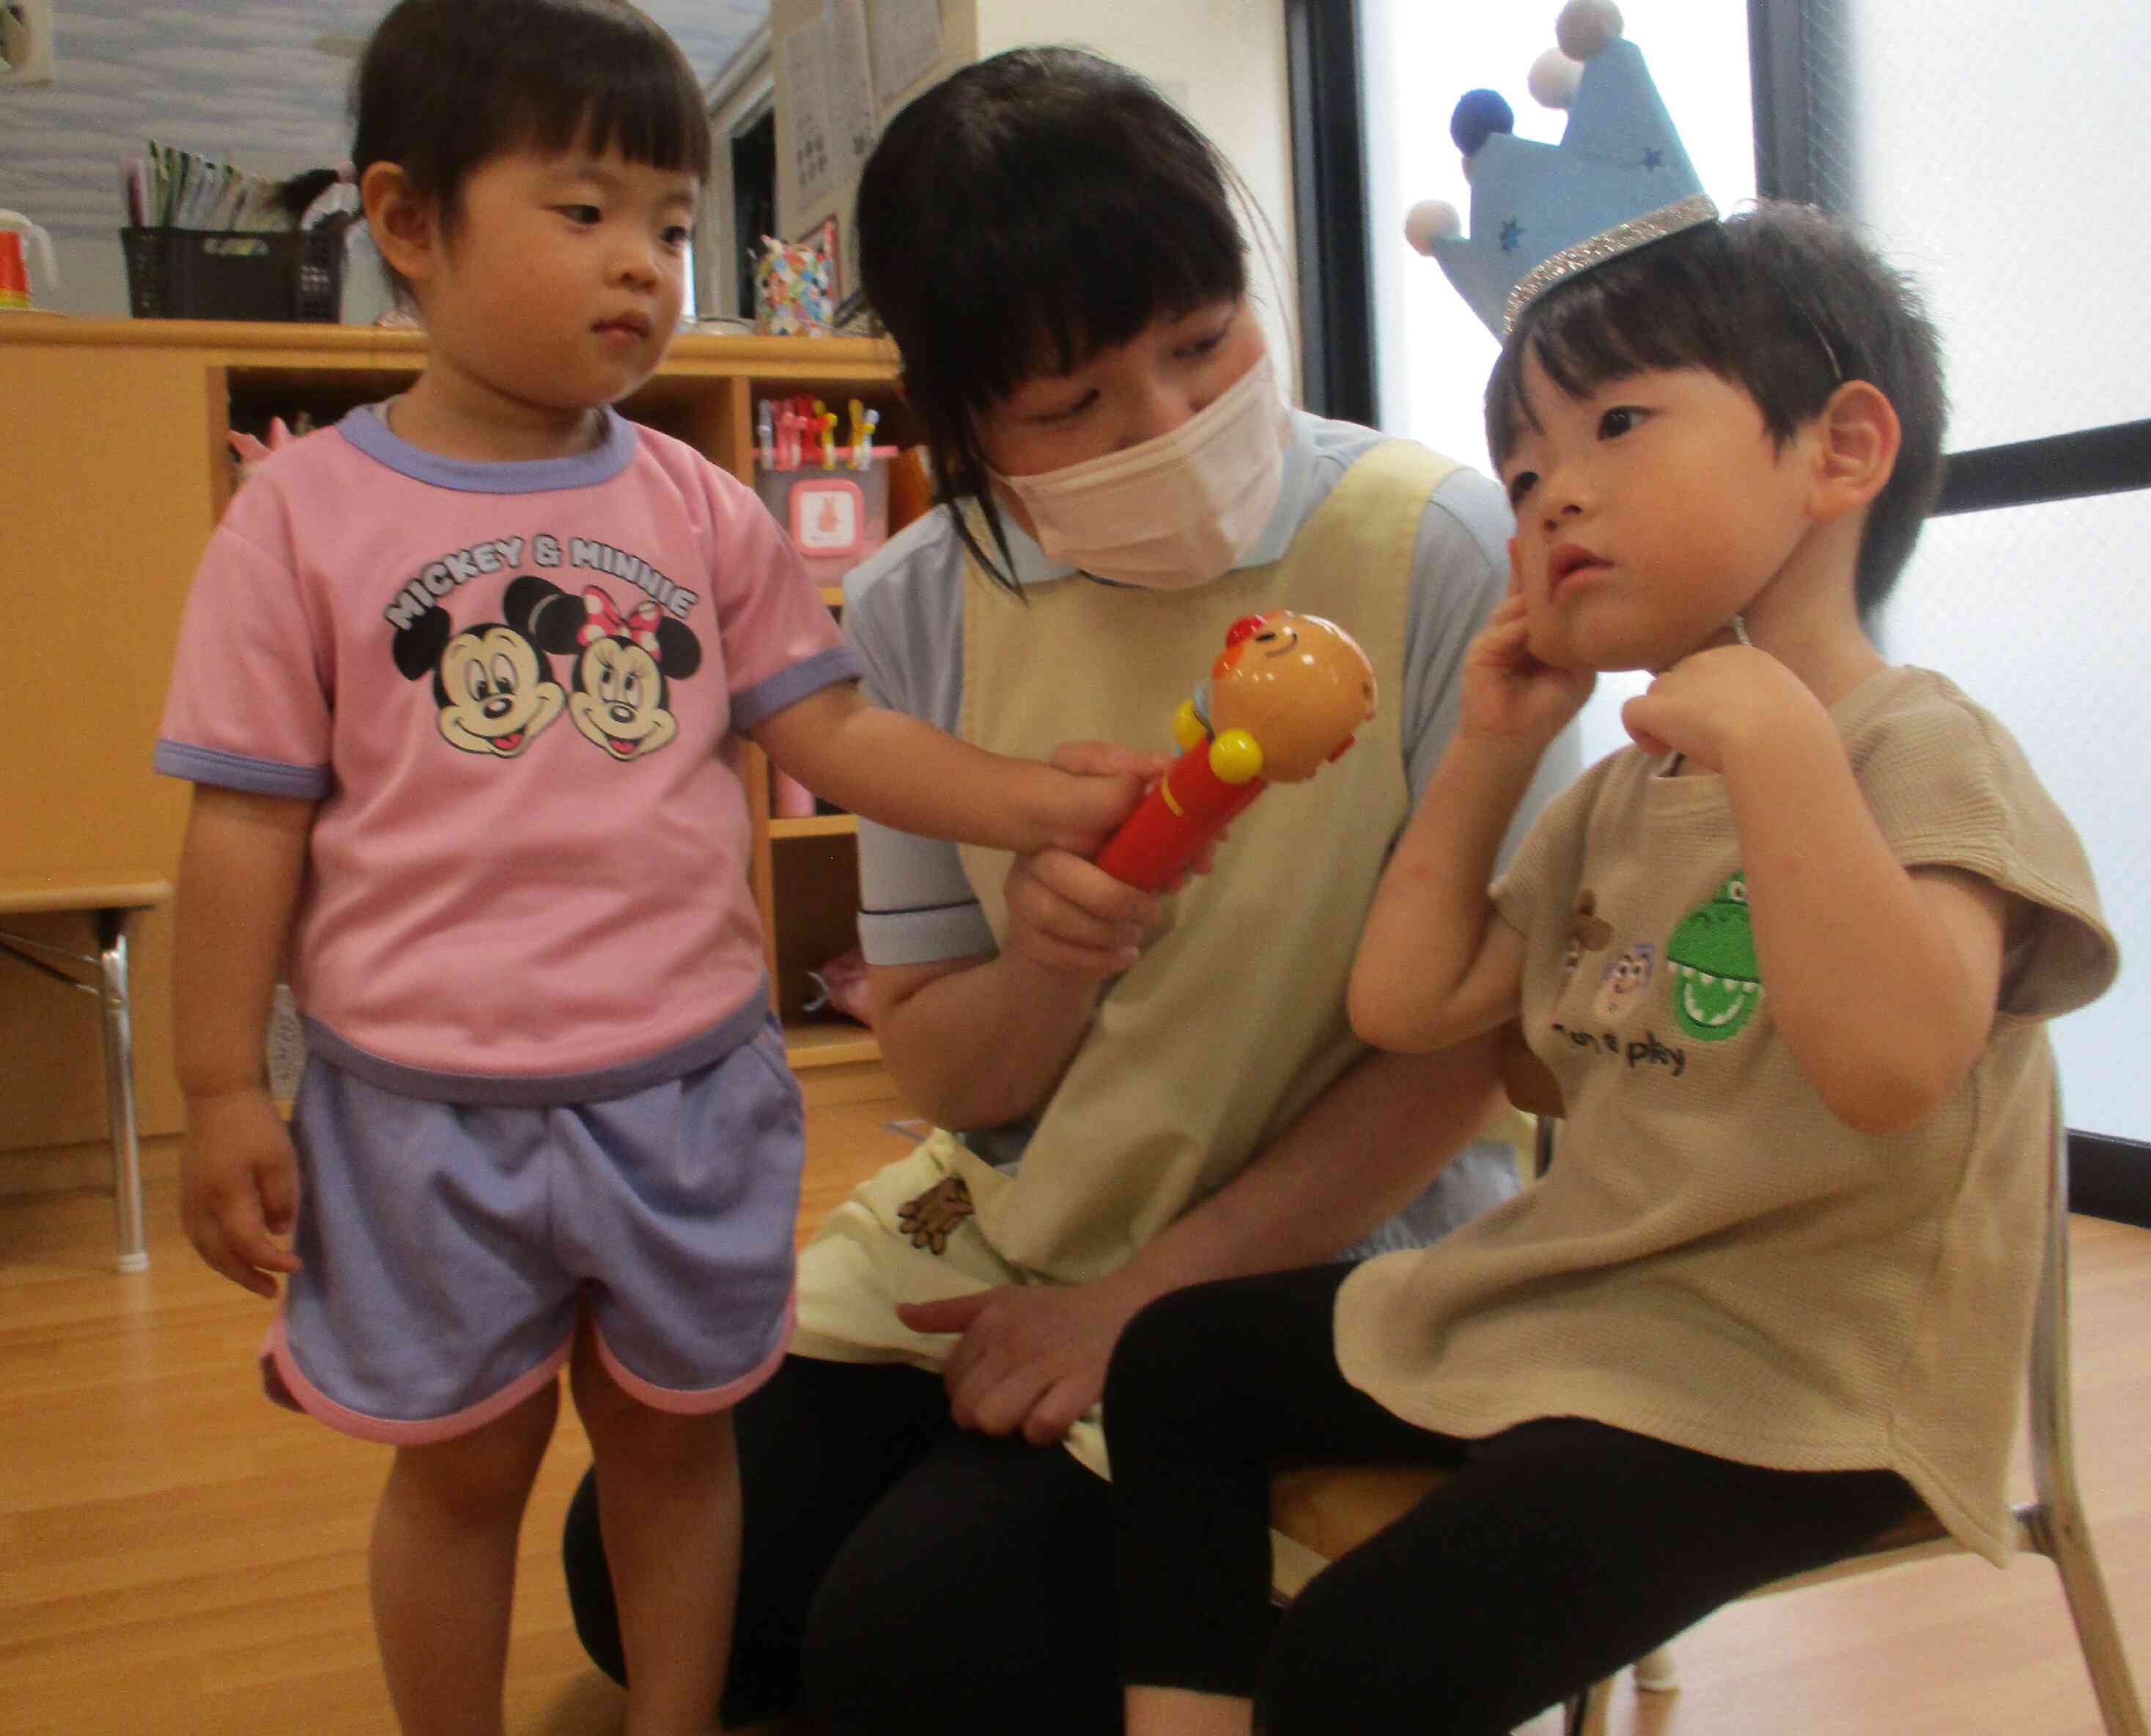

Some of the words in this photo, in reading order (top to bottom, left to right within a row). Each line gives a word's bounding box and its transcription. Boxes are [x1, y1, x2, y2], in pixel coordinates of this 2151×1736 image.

[384, 535, 524, 631] MICKEY
[534, 533, 562, 567] &
[570, 536, 699, 619] MINNIE
